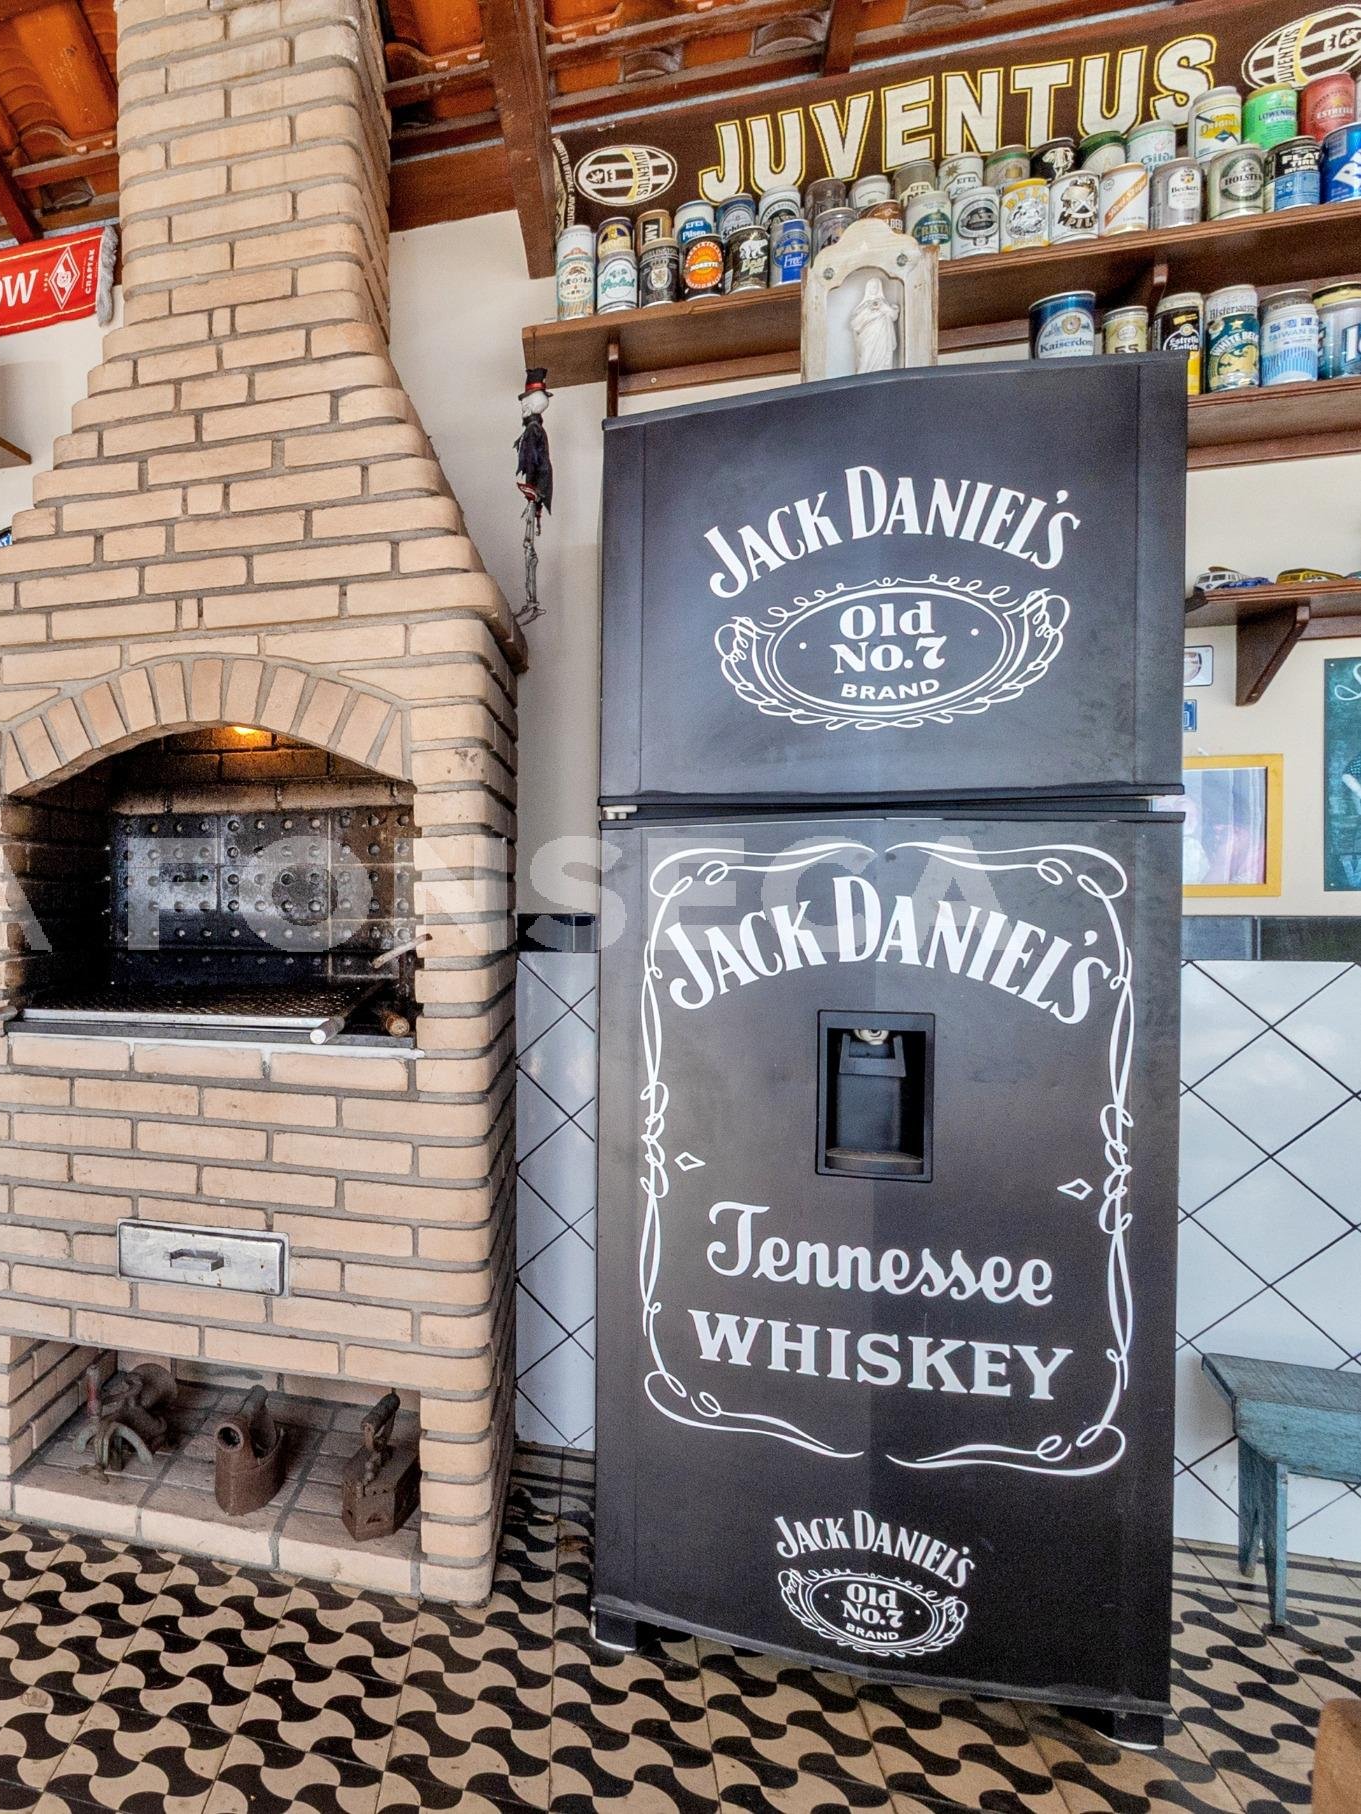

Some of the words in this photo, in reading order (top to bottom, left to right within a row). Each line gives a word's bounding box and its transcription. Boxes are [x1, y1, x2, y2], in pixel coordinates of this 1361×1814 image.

[699, 33, 1217, 207] JUVENTUS
[634, 150, 650, 198] JUVENTUS
[567, 195, 576, 227] JUVENTU
[704, 491, 842, 598] JACK
[844, 466, 1081, 570] DANIEL'S
[840, 600, 935, 640] Old
[840, 678, 941, 700] BRAND
[665, 900, 827, 1010] JACK
[833, 876, 1112, 1025] DANIEL'S
[706, 1200, 1054, 1307] Tennessee
[687, 1308, 1074, 1402] WHISKEY
[775, 1516, 851, 1558] JACK
[852, 1509, 976, 1588] DANIEL'S
[846, 1583, 898, 1609] Old
[845, 1622, 900, 1641] BRAND
